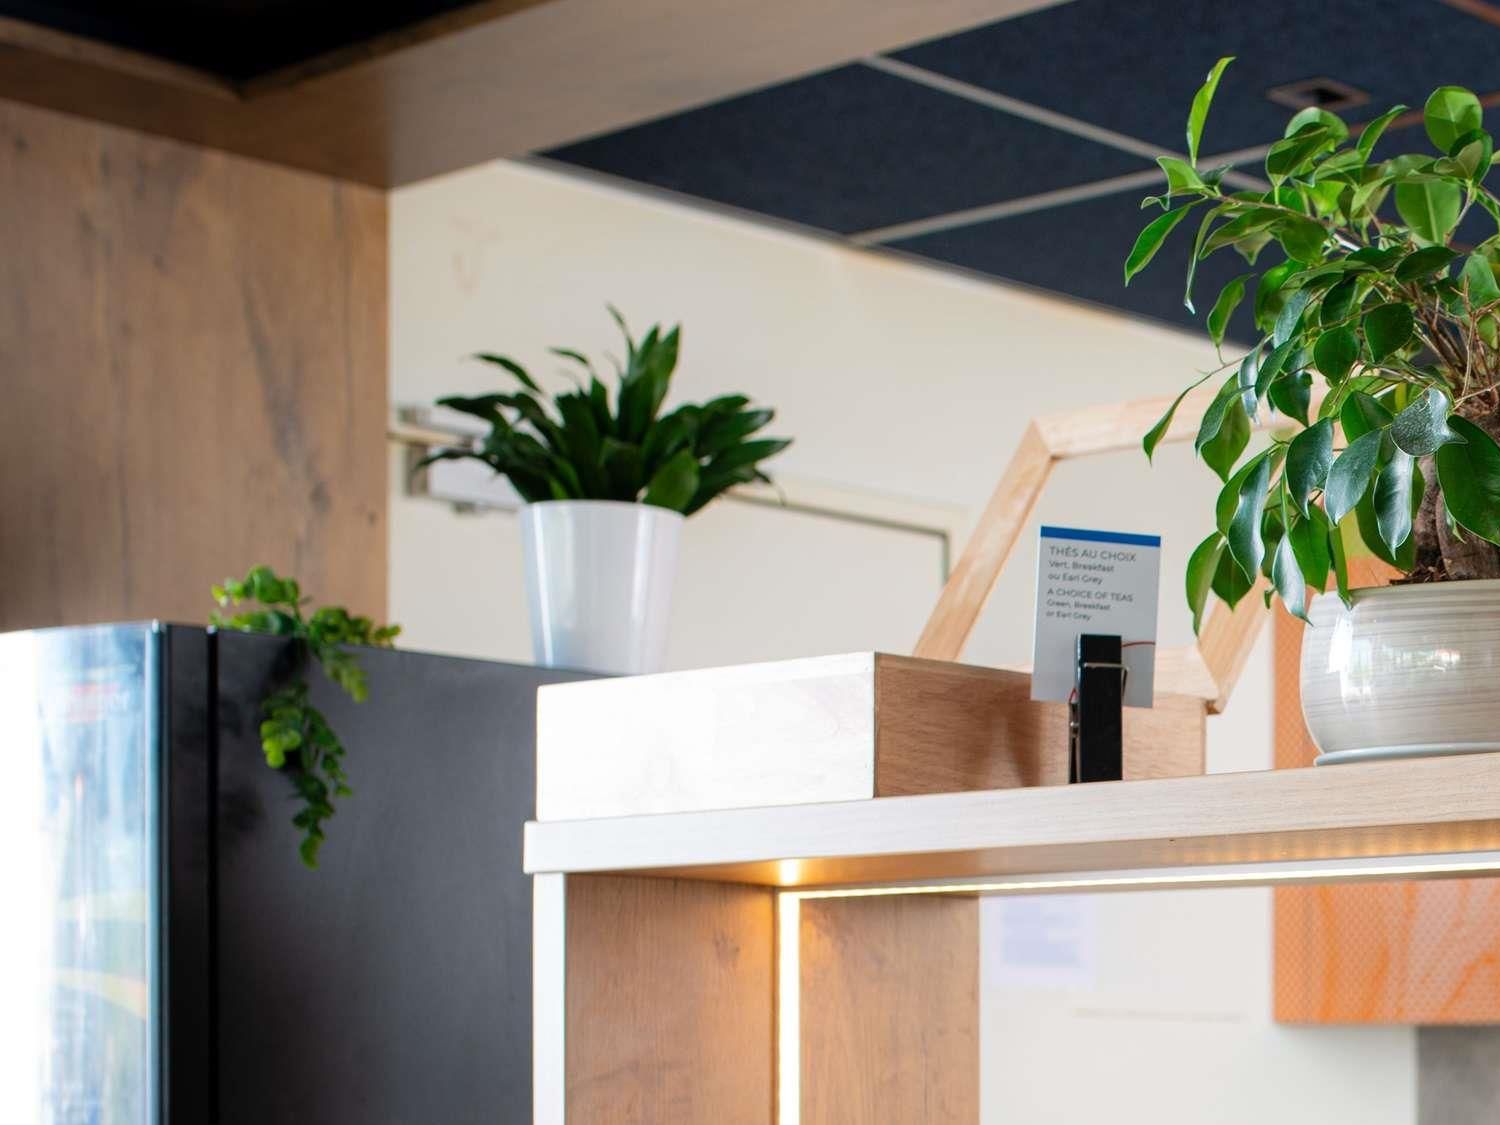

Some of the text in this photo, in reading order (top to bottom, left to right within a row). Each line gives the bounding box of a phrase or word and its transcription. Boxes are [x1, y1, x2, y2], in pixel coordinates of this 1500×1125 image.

[1050, 545, 1137, 562] THÉS AU CHOIX
[1072, 562, 1115, 573] Breakfast
[1062, 573, 1079, 581] Earl
[1081, 575, 1103, 585] Grey
[1056, 588, 1093, 599] CHOICE
[1095, 591, 1108, 600] OF
[1111, 592, 1134, 603] TEAS
[1074, 602, 1111, 611] Breakfast
[1073, 612, 1092, 621] Grey
